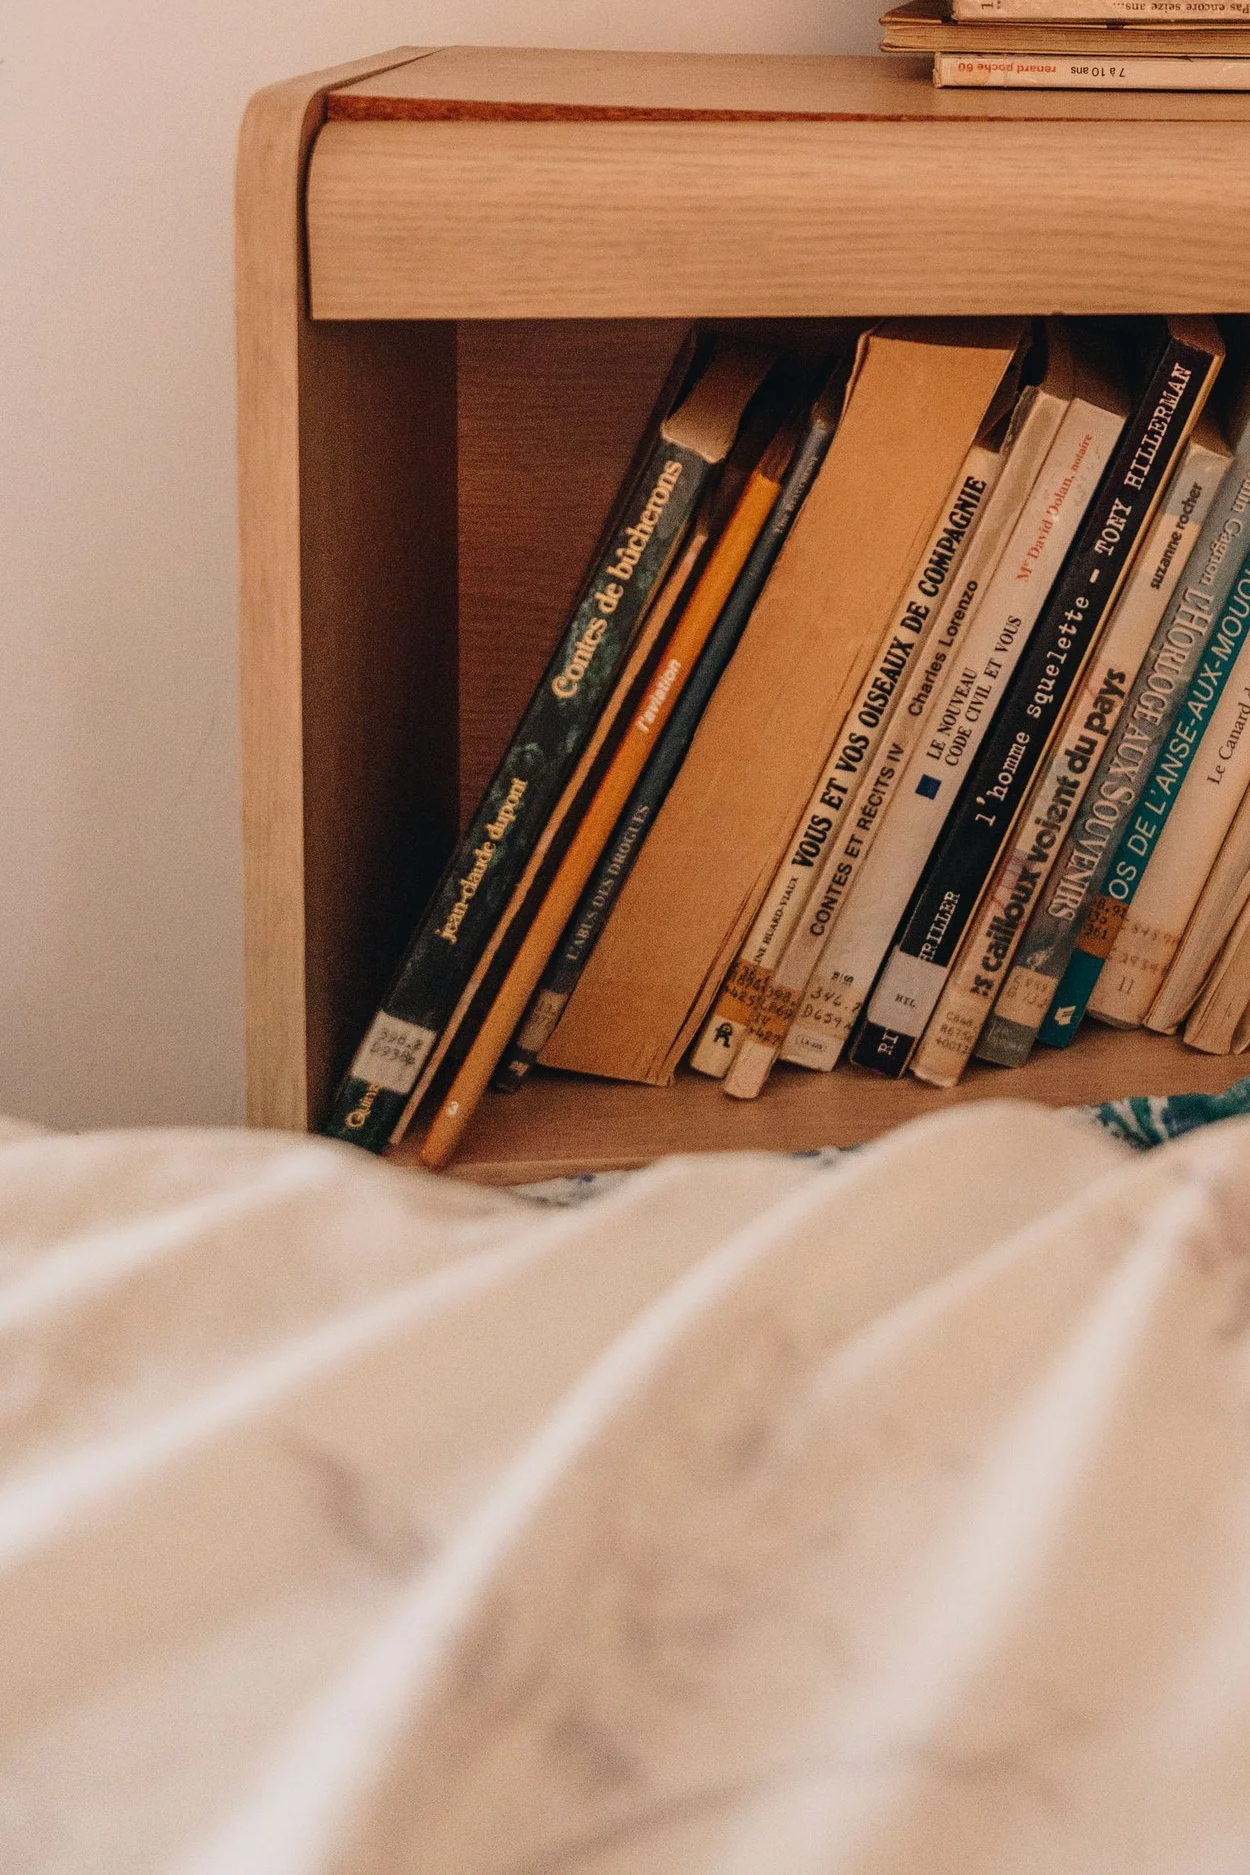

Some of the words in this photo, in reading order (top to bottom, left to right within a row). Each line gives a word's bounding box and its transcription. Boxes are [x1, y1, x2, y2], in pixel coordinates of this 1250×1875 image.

[1150, 2, 1182, 13] seize
[1186, 3, 1225, 13] encore
[1230, 3, 1249, 16] Pas
[977, 62, 1013, 74] poche
[1016, 63, 1057, 74] renard
[1070, 66, 1090, 75] ans
[607, 460, 684, 581] bûcherons
[1027, 519, 1055, 560] David
[1070, 431, 1094, 472] notaire
[1150, 529, 1183, 591] suzanne
[1176, 480, 1205, 529] rocher
[595, 582, 624, 614] de
[975, 730, 1031, 827] l'homme
[1026, 595, 1089, 719] squelette
[1094, 497, 1132, 558] TONY
[1123, 362, 1192, 492] HILLERMAN
[1199, 518, 1242, 587] Gagnon
[552, 616, 607, 698] Contes
[636, 658, 682, 733] l'aviation
[791, 814, 833, 869] VOUS
[820, 777, 849, 812] ET
[835, 732, 870, 773] VOS
[858, 640, 914, 730] OISEAUX
[900, 600, 931, 635] DE
[918, 475, 986, 598] COMPAGNIE
[908, 650, 948, 717] Charles
[939, 578, 979, 648] Lorenzo
[943, 727, 972, 767] CODE
[964, 681, 992, 727] CIVIL
[983, 656, 1002, 682] ET
[995, 614, 1023, 657] VOUS
[1132, 587, 1215, 727] L'HORLOGE
[926, 736, 947, 762] LE
[938, 666, 978, 737] NOUVEAU
[1107, 722, 1150, 785] AUX
[982, 868, 1042, 972] cailloux
[1064, 732, 1098, 775] du
[1085, 666, 1127, 737] pays
[1207, 762, 1228, 785] Le
[435, 838, 497, 946] jean-claude
[485, 776, 528, 841] dupont
[592, 878, 616, 909] DES
[608, 803, 650, 878] DROGUES
[809, 862, 853, 938] CONTES
[845, 832, 865, 861] ET
[855, 765, 896, 834] RÉCITS
[887, 741, 907, 773] IV
[1048, 780, 1135, 922] SOUVENIRS
[1127, 815, 1157, 857] DE
